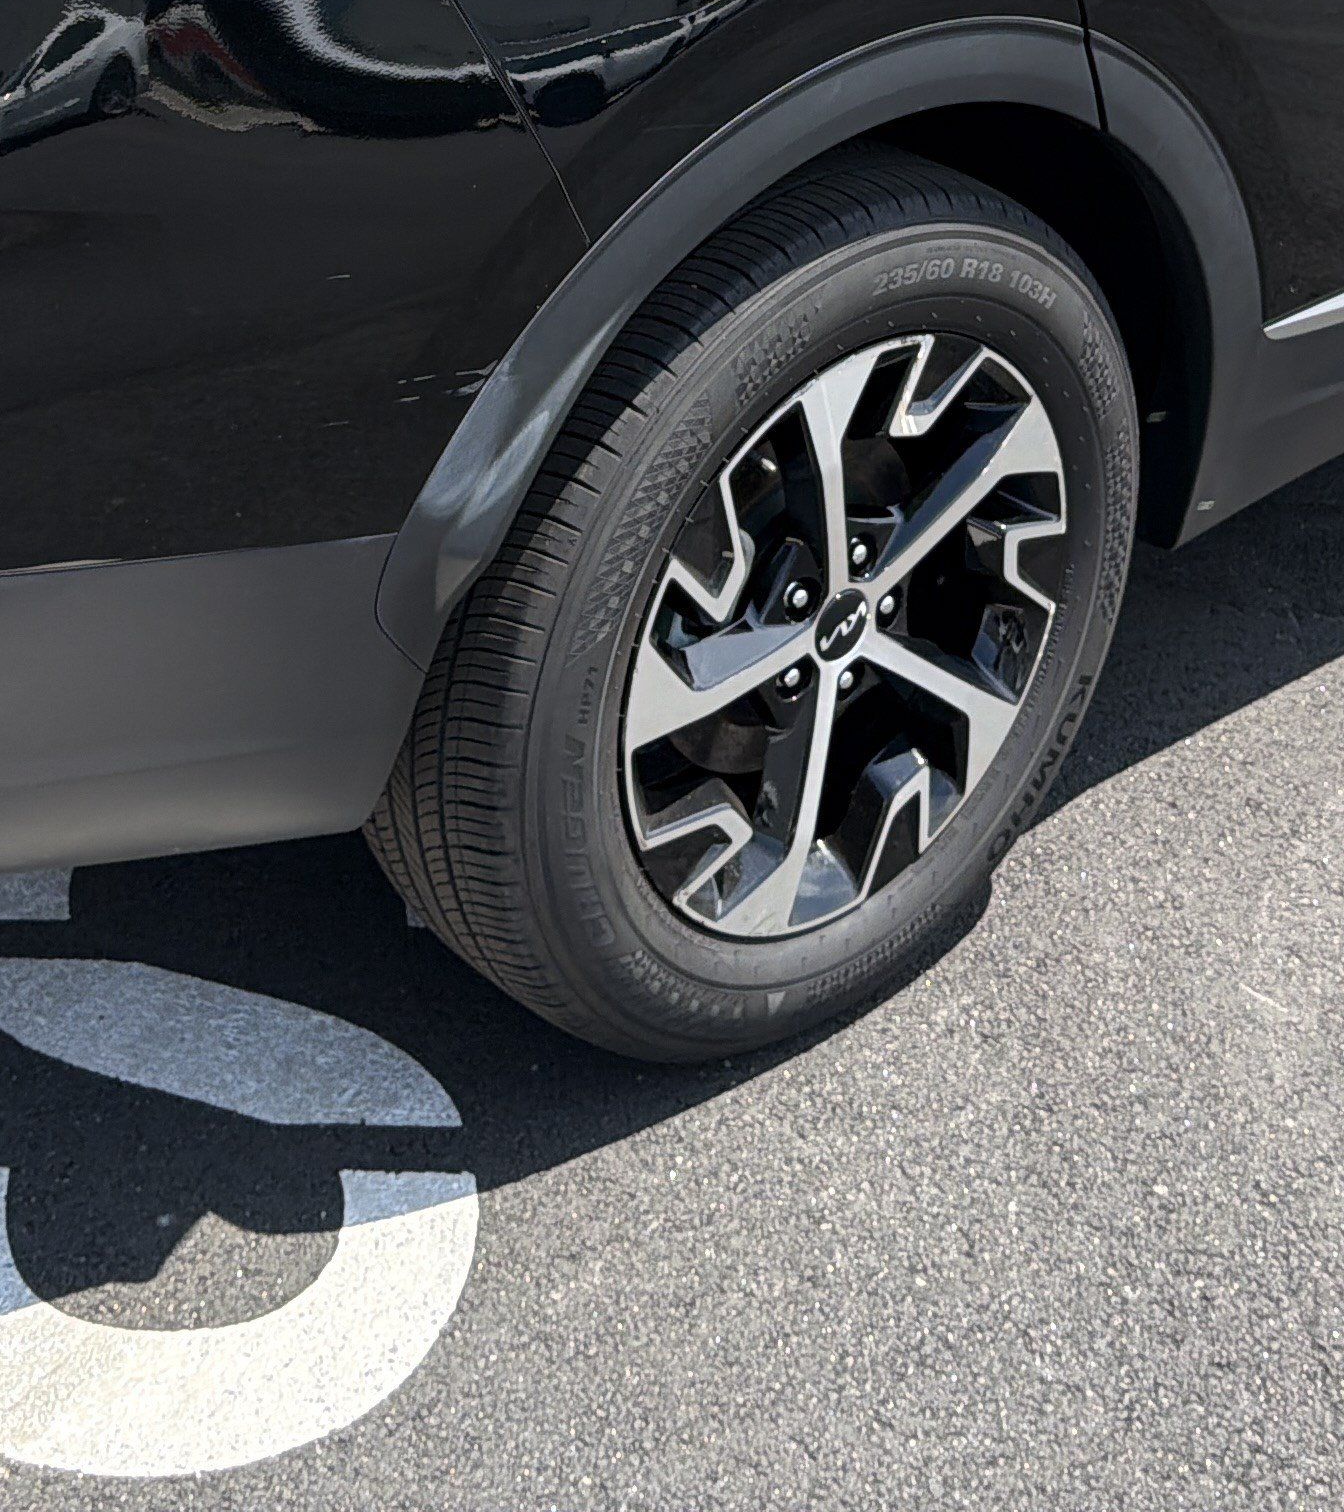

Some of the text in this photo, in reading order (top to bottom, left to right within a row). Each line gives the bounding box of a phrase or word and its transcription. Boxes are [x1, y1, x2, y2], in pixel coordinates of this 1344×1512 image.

[872, 257, 1056, 310] 235/60 R18 103H
